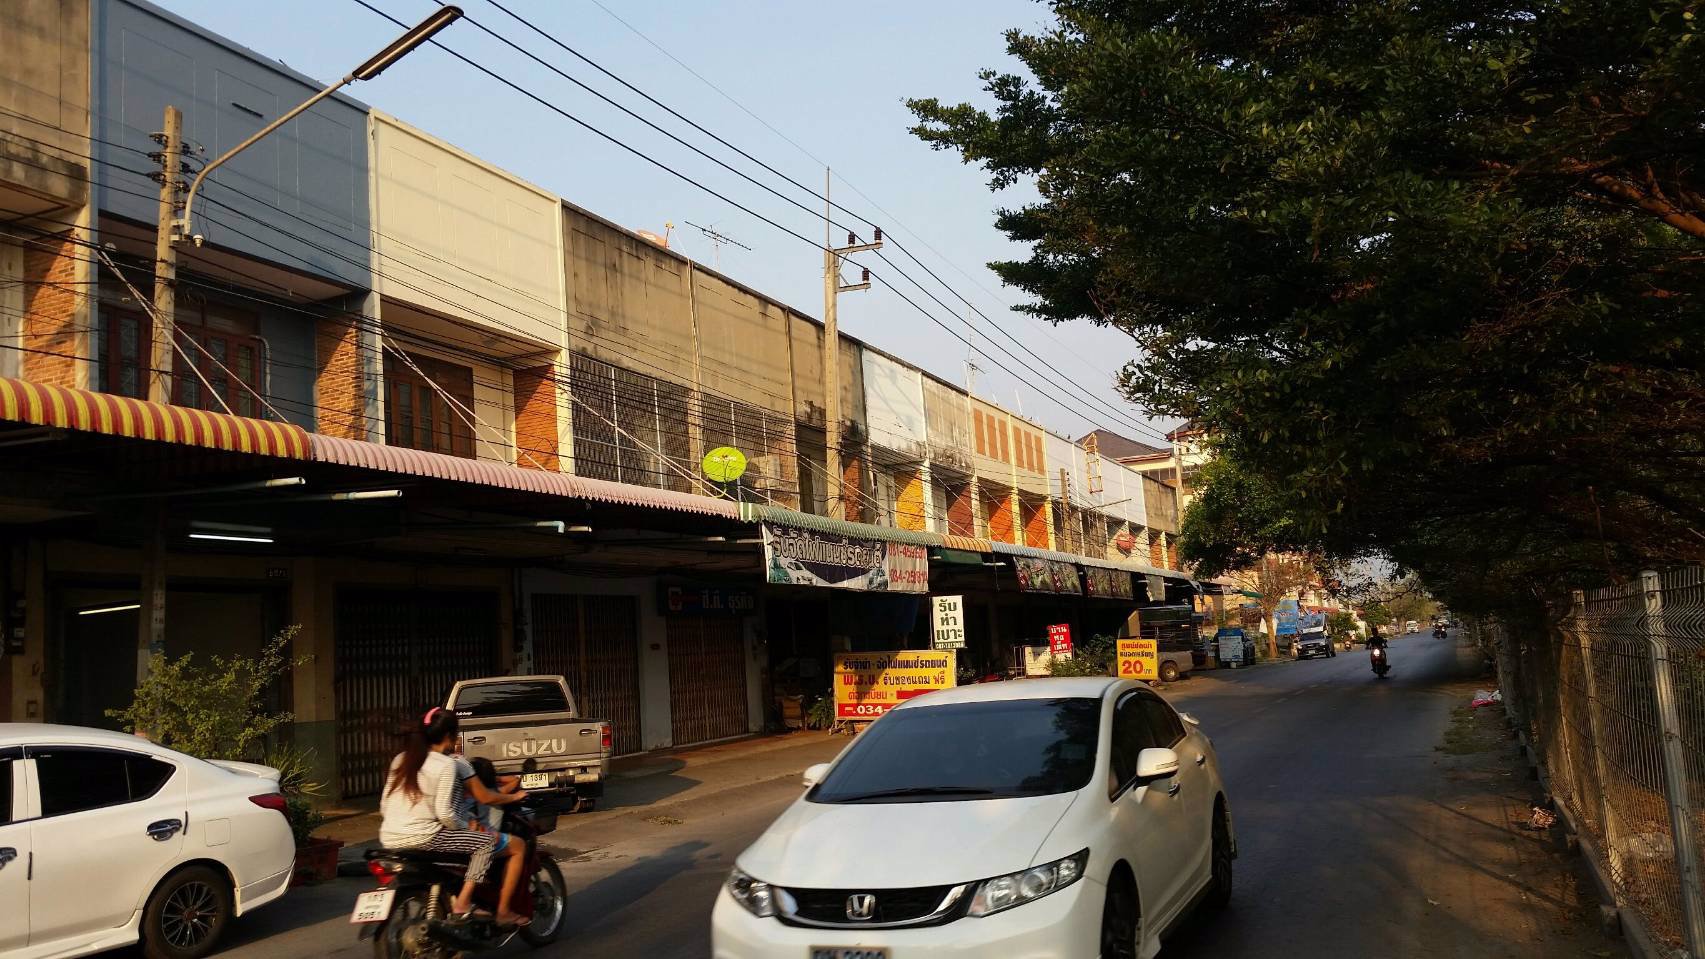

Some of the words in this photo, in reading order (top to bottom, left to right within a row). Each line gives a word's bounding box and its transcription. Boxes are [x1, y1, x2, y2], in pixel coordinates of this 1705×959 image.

[939, 598, 957, 612] รับ
[940, 613, 957, 626] ทำ
[936, 629, 962, 641] เบาะ
[1122, 660, 1144, 675] 20
[503, 738, 567, 757] ISUZU
